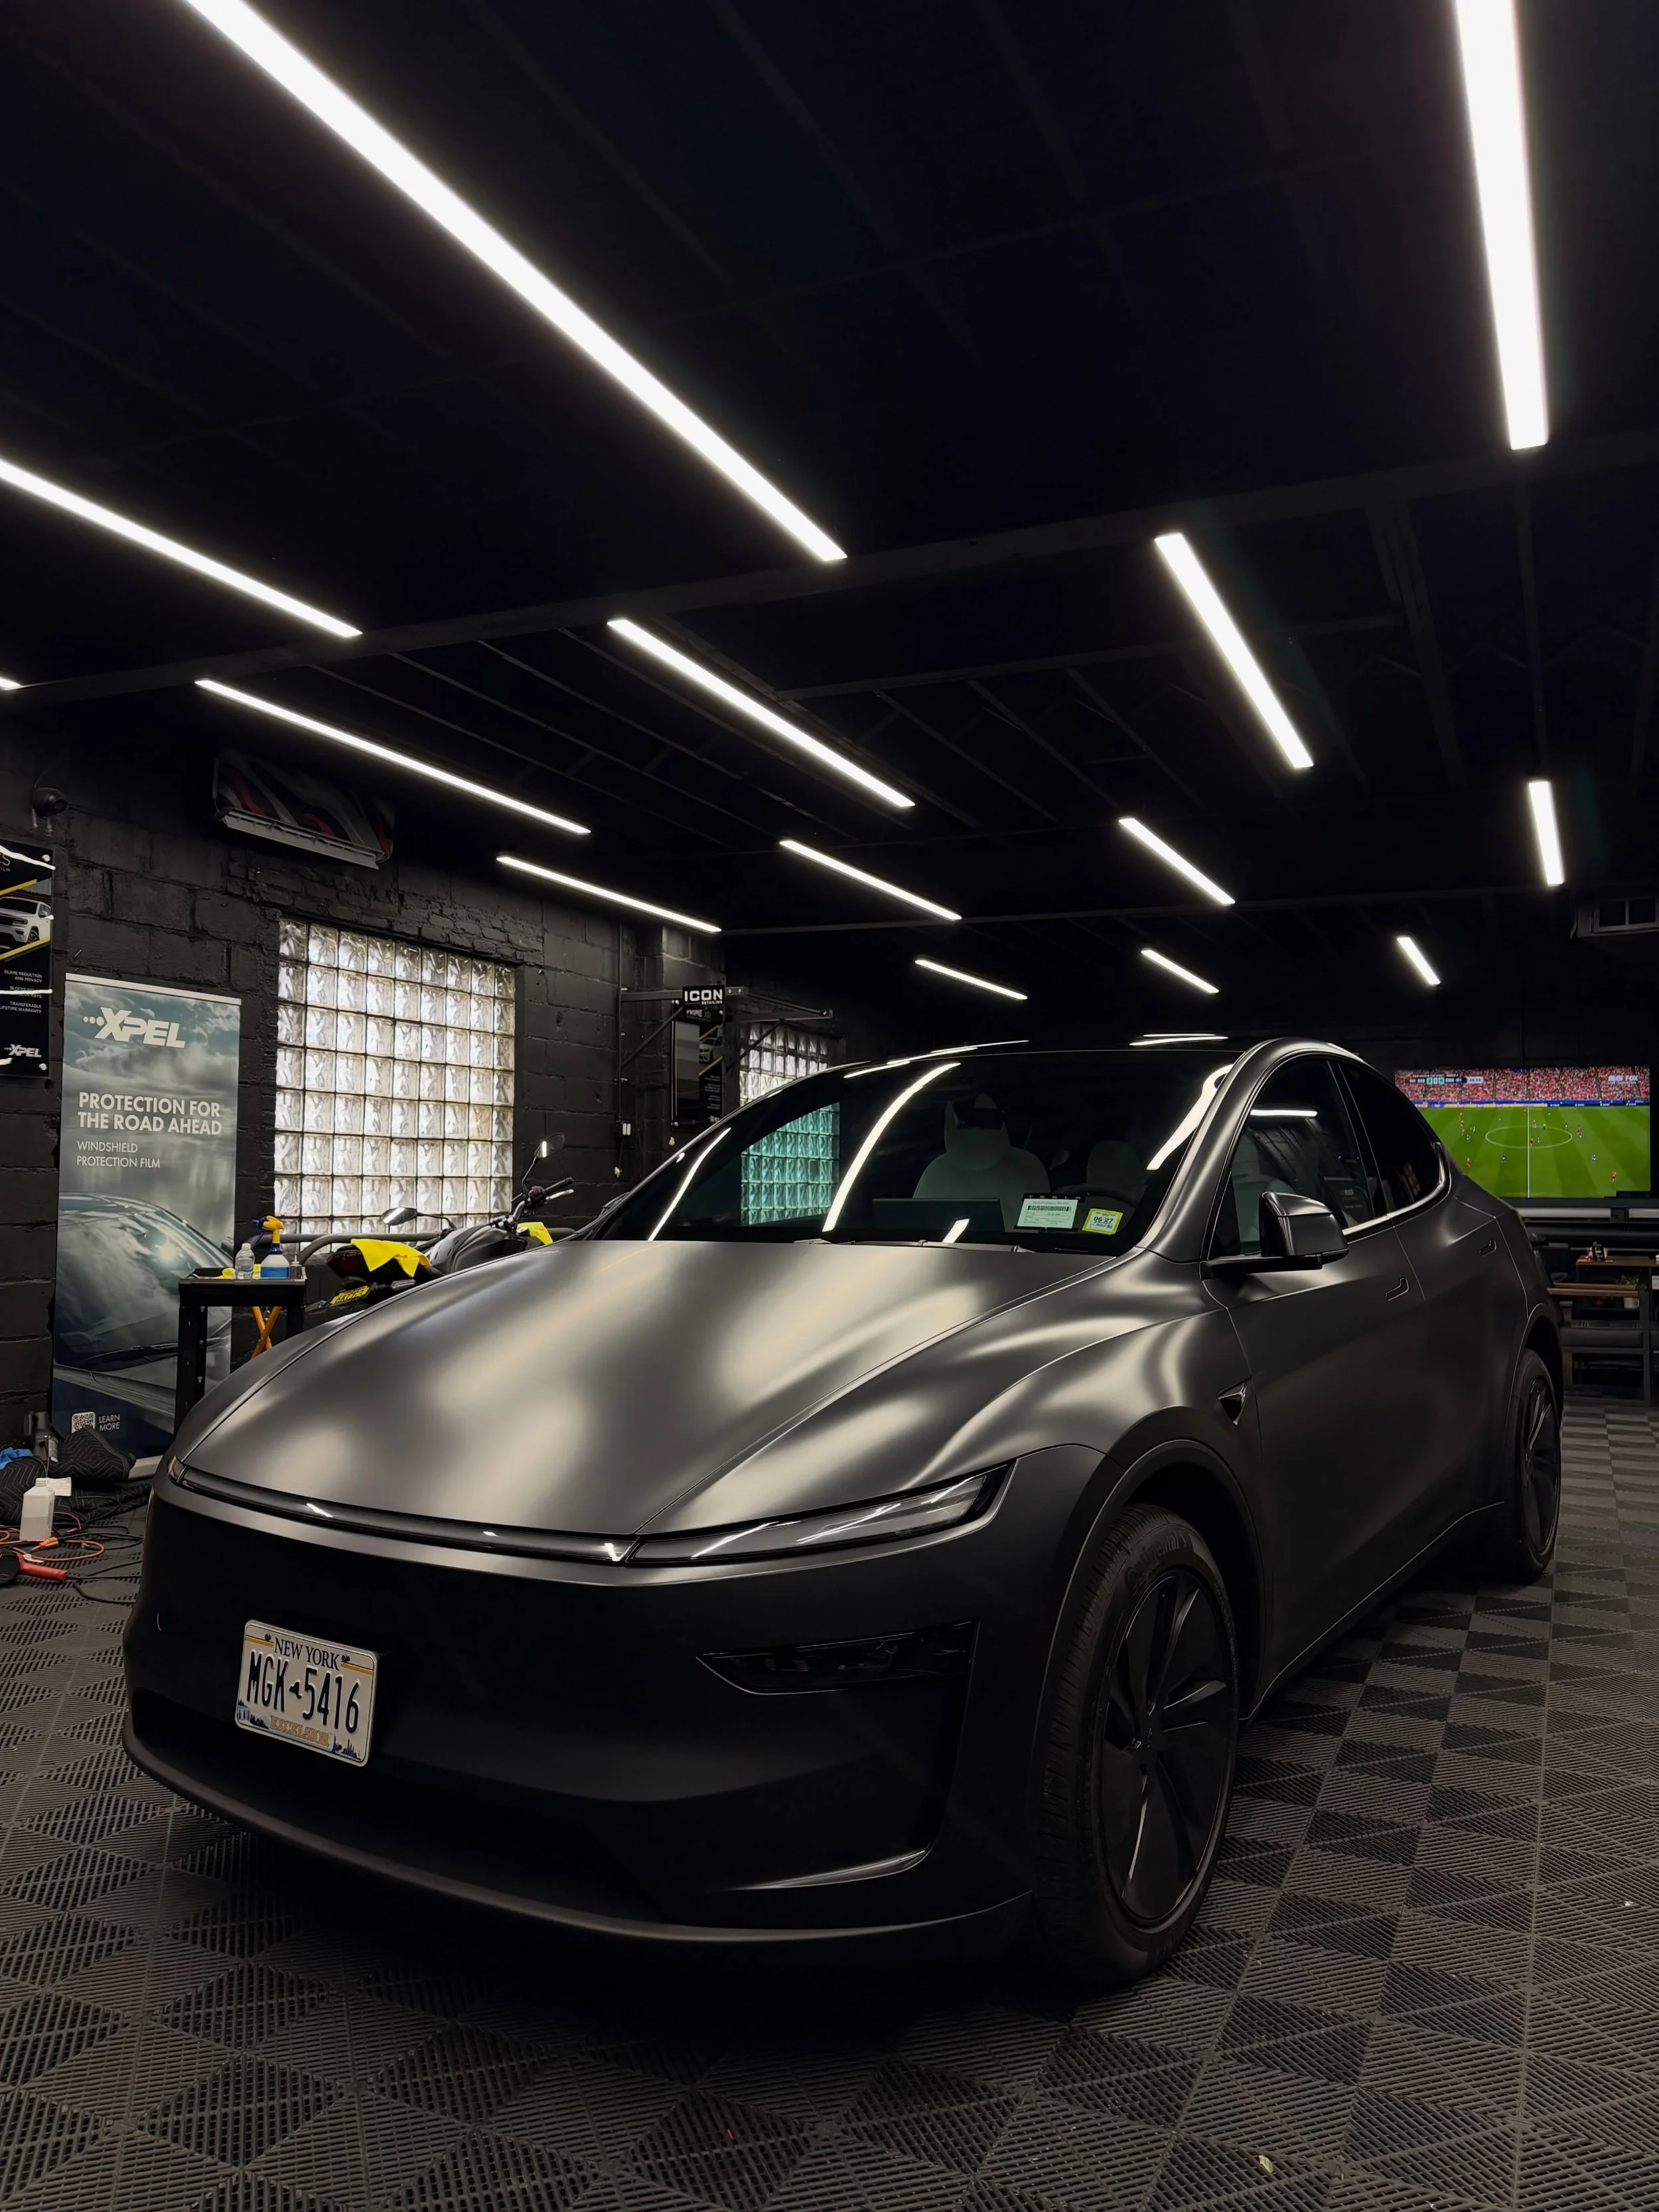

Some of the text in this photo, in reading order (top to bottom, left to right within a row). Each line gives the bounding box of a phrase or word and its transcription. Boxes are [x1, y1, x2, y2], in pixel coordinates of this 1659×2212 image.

[684, 989, 723, 1002] ICON
[94, 1007, 186, 1049] XPEL
[8, 1043, 42, 1058] XPEL
[79, 1092, 221, 1118] PROTECTION FOR
[78, 1112, 222, 1136] THE ROAD AHEAD
[77, 1141, 138, 1153] WINDSHIELD
[76, 1155, 161, 1169] PROTECTION FILM
[99, 1414, 121, 1424] LEARN
[99, 1422, 120, 1432] MORE
[274, 1637, 340, 1670] NEW YORK
[247, 1651, 360, 1733] MGK 5416
[270, 1715, 330, 1747] EXCELSIOR
